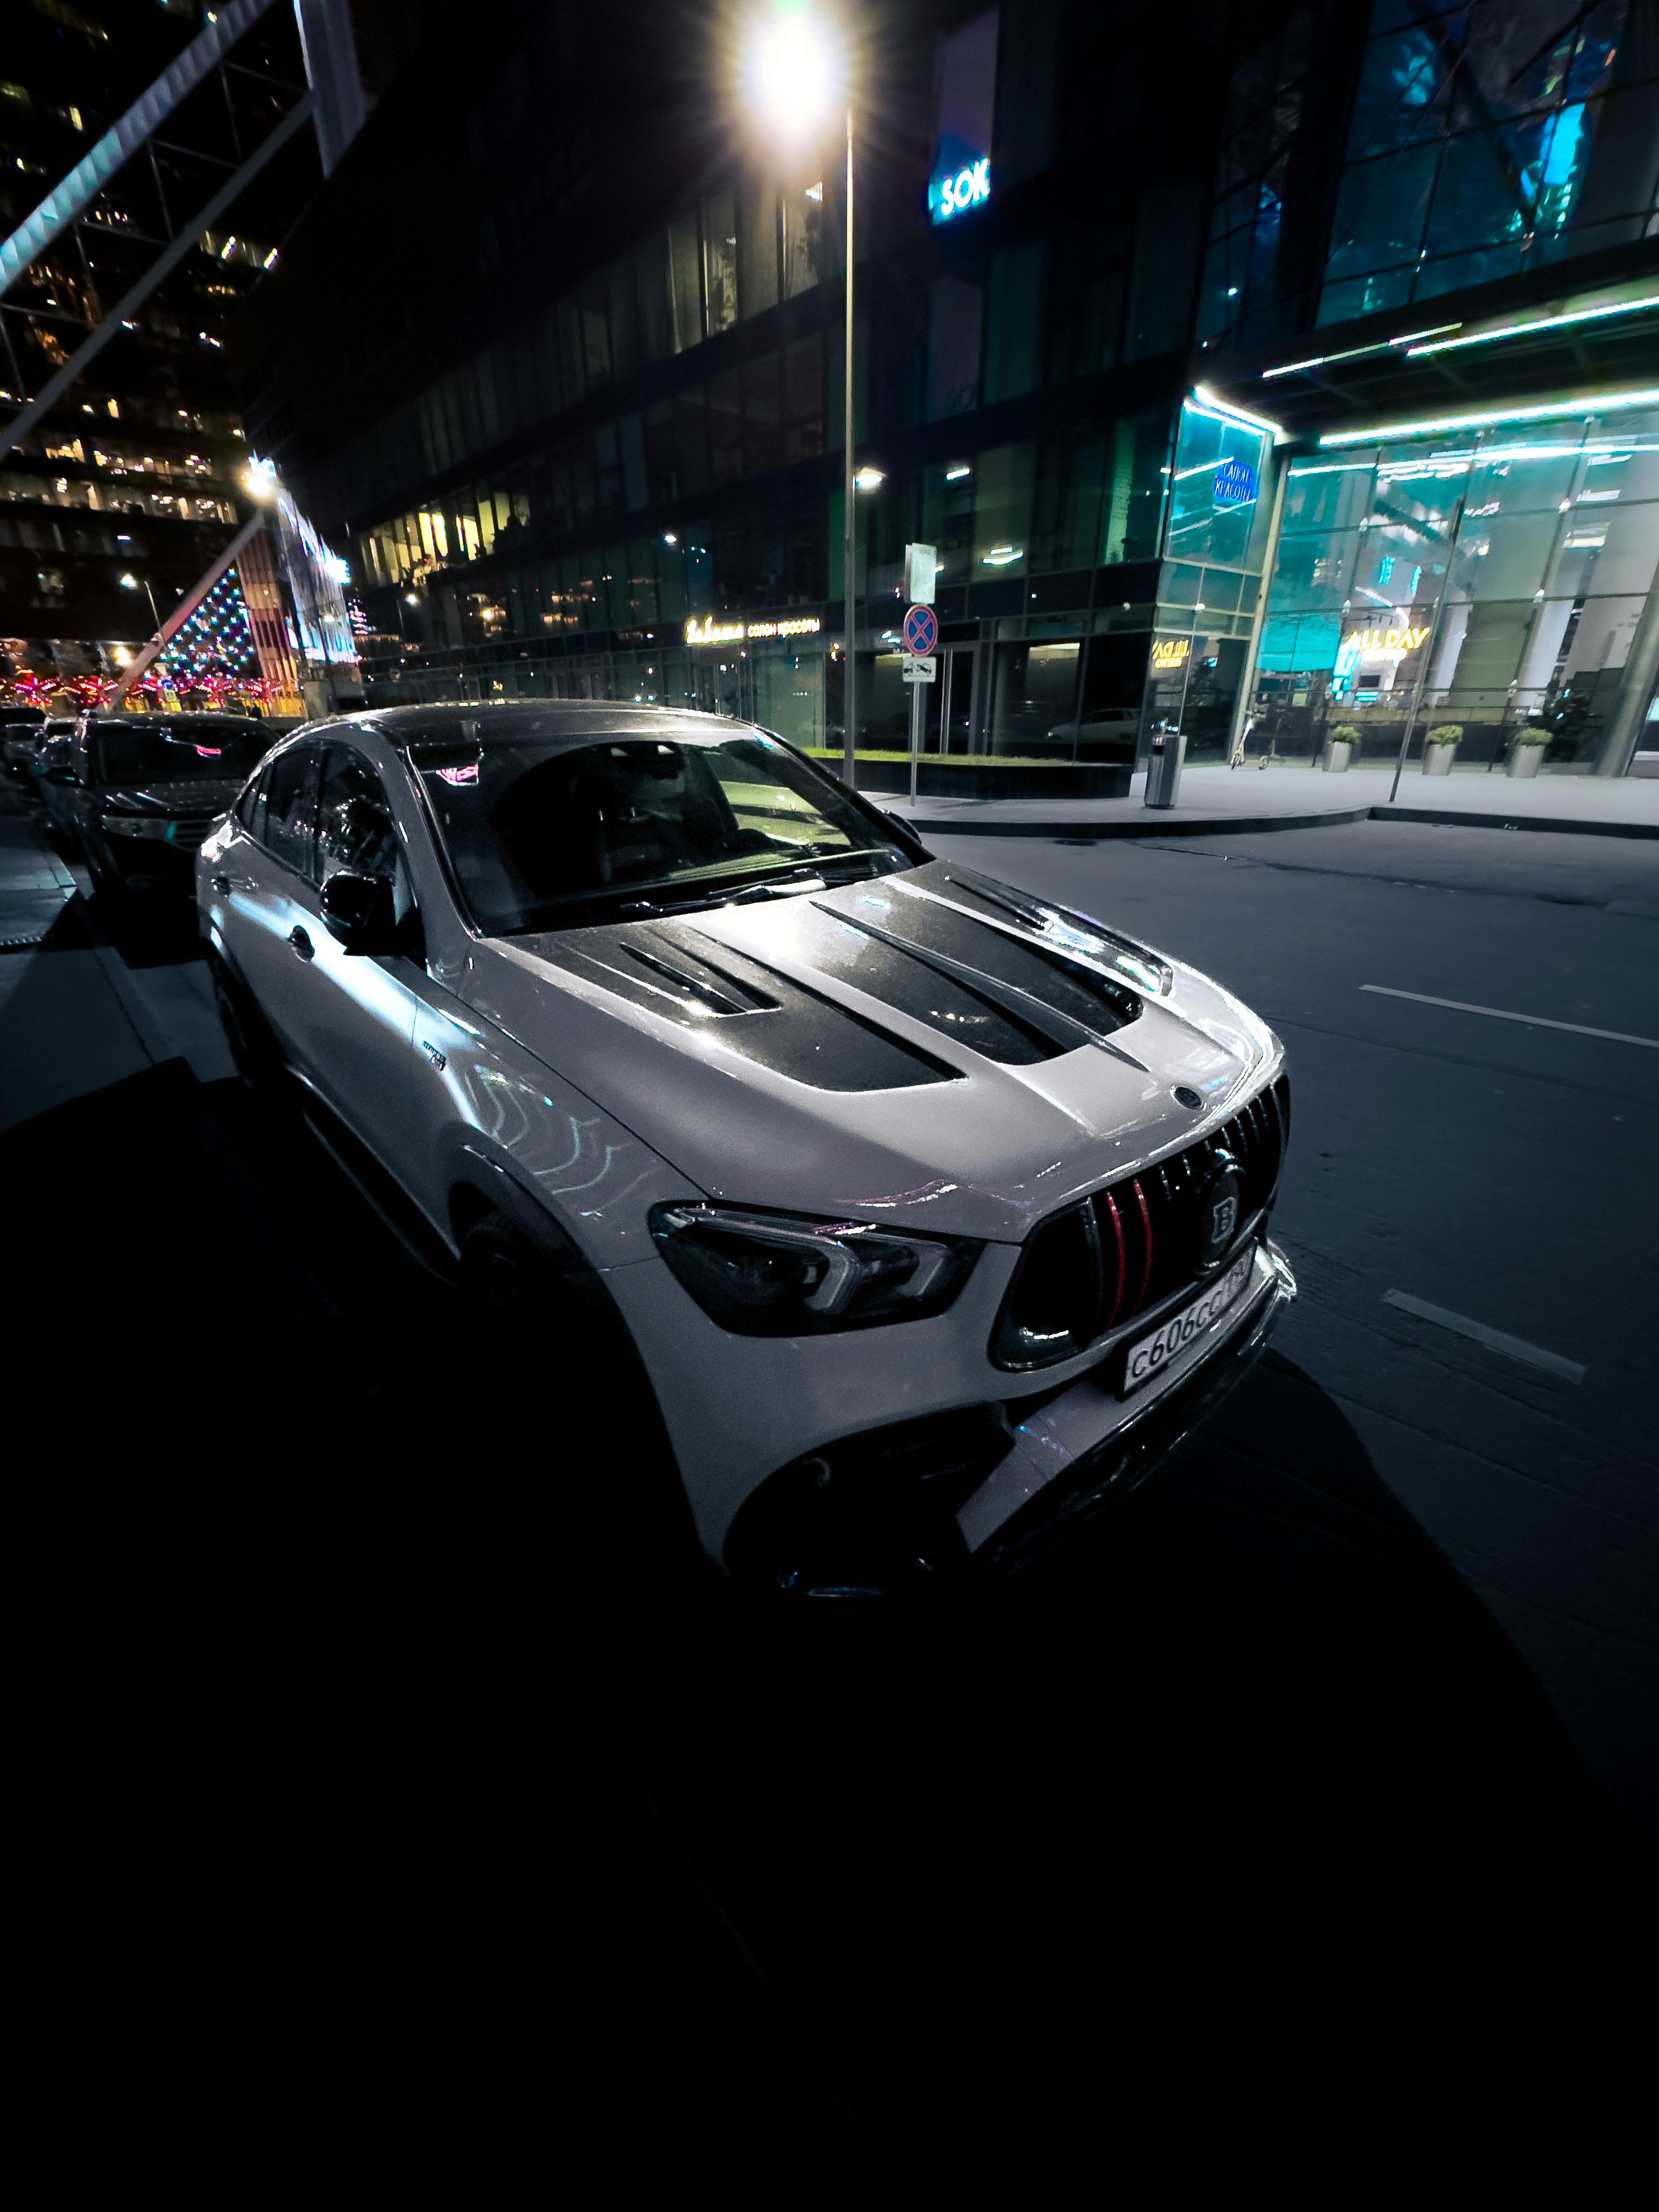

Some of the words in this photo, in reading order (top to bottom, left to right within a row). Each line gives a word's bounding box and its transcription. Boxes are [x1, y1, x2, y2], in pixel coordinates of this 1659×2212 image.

[941, 158, 989, 216] SOK
[1223, 464, 1250, 483] САЛОН
[1342, 630, 1381, 651] ALL
[1384, 627, 1430, 649] DAY
